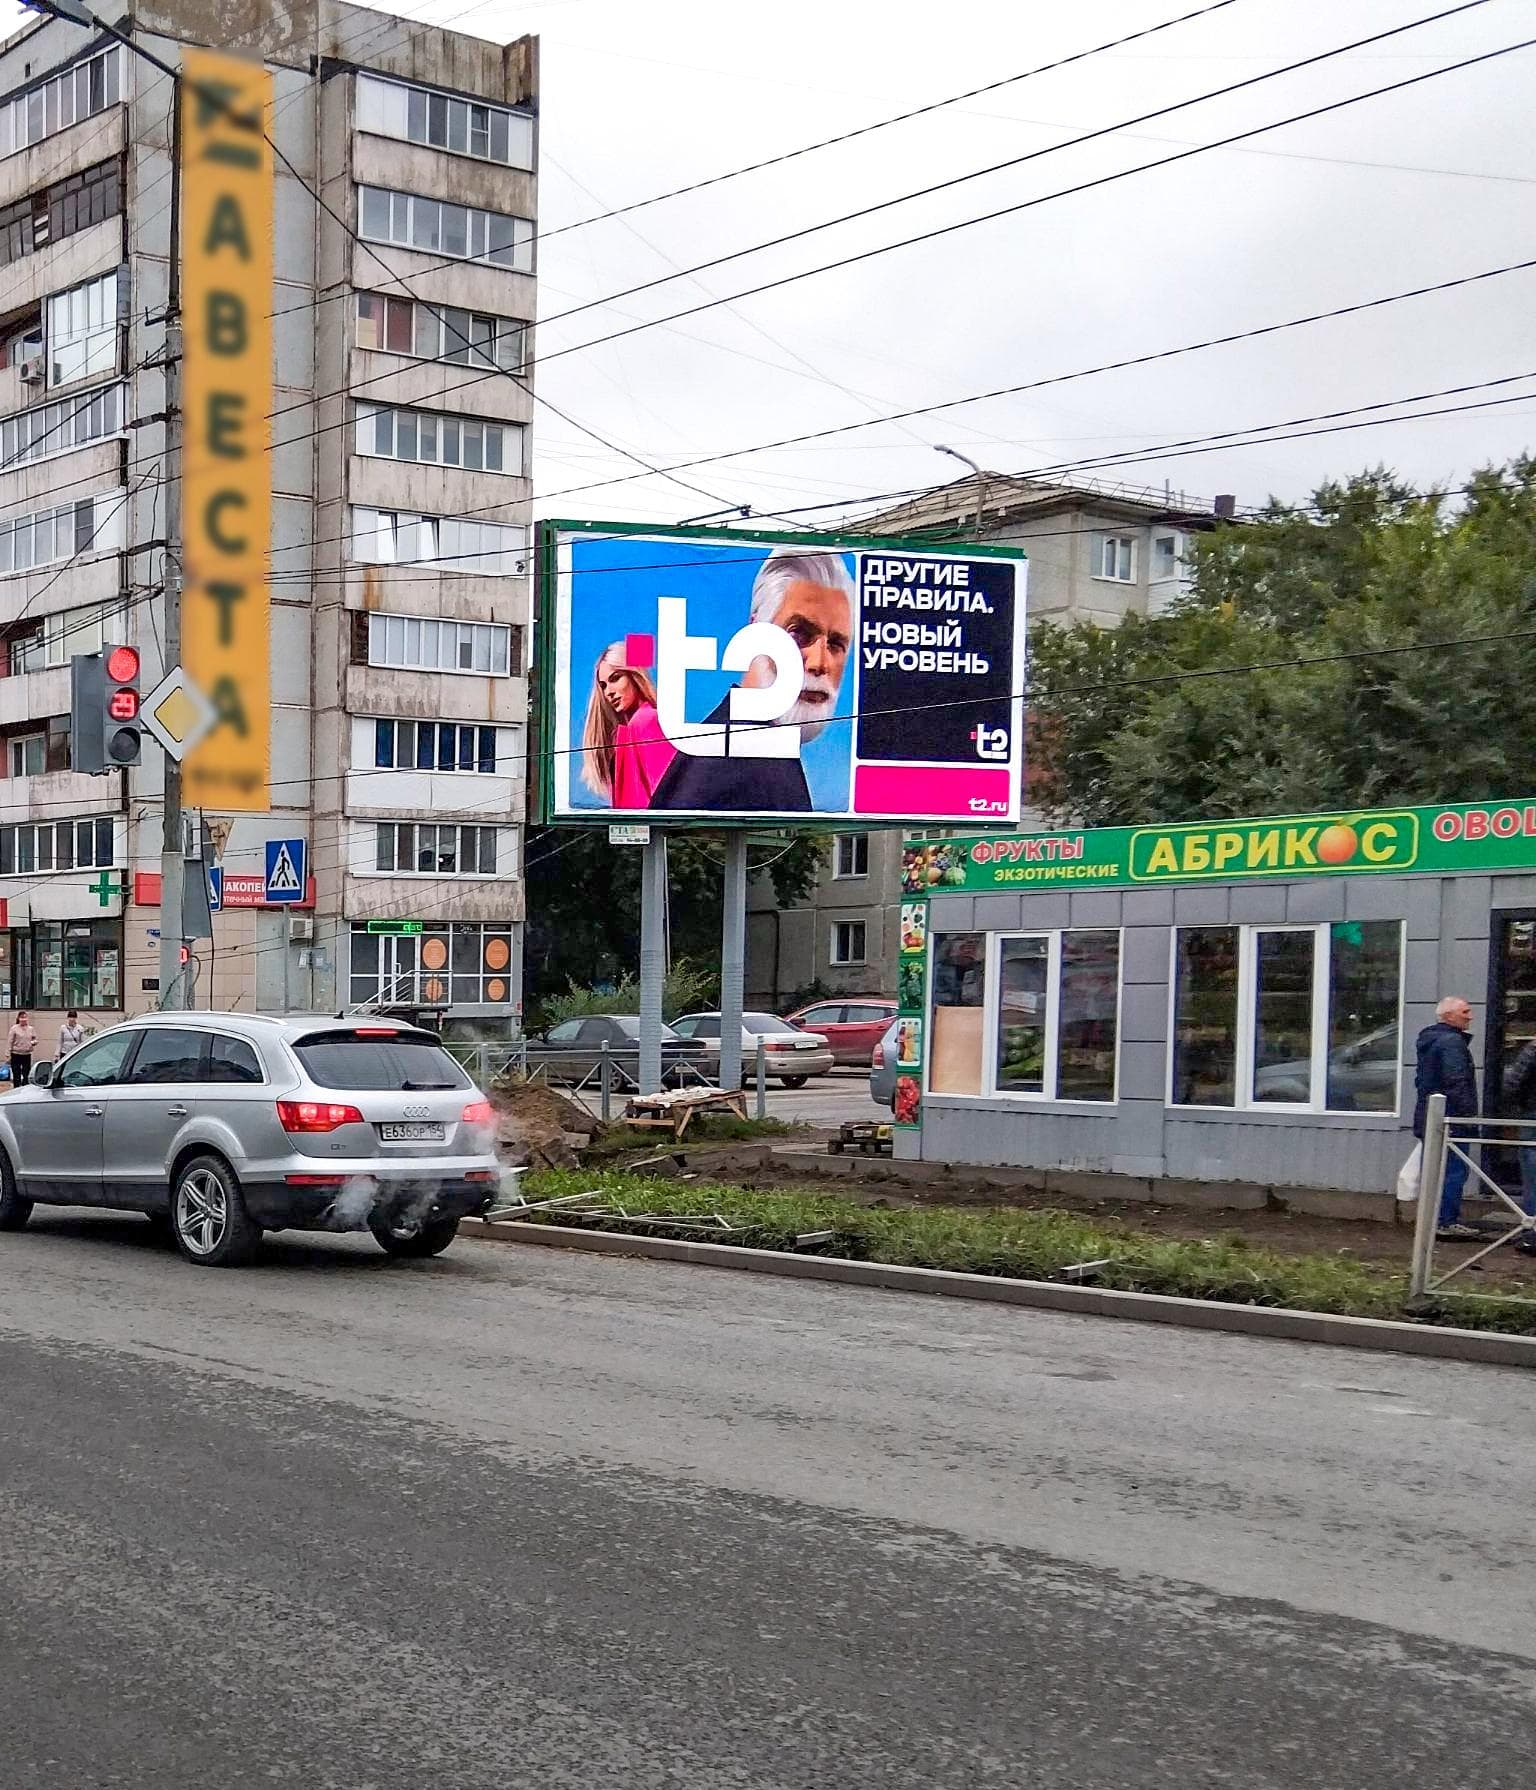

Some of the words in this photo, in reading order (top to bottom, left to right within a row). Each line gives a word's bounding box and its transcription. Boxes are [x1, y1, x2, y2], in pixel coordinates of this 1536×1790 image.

[864, 559, 969, 586] ДРУГИЕ
[863, 585, 994, 614] ПРАВИЛА.
[862, 619, 962, 647] НОВЫЙ
[862, 647, 989, 675] УРОВЕНЬ
[969, 723, 1008, 760] t2
[968, 797, 1007, 812] t2.ru
[971, 836, 1084, 864] ФРУКТЫ
[994, 864, 1119, 881] ЭКЗОТИЧЕСКИЕ
